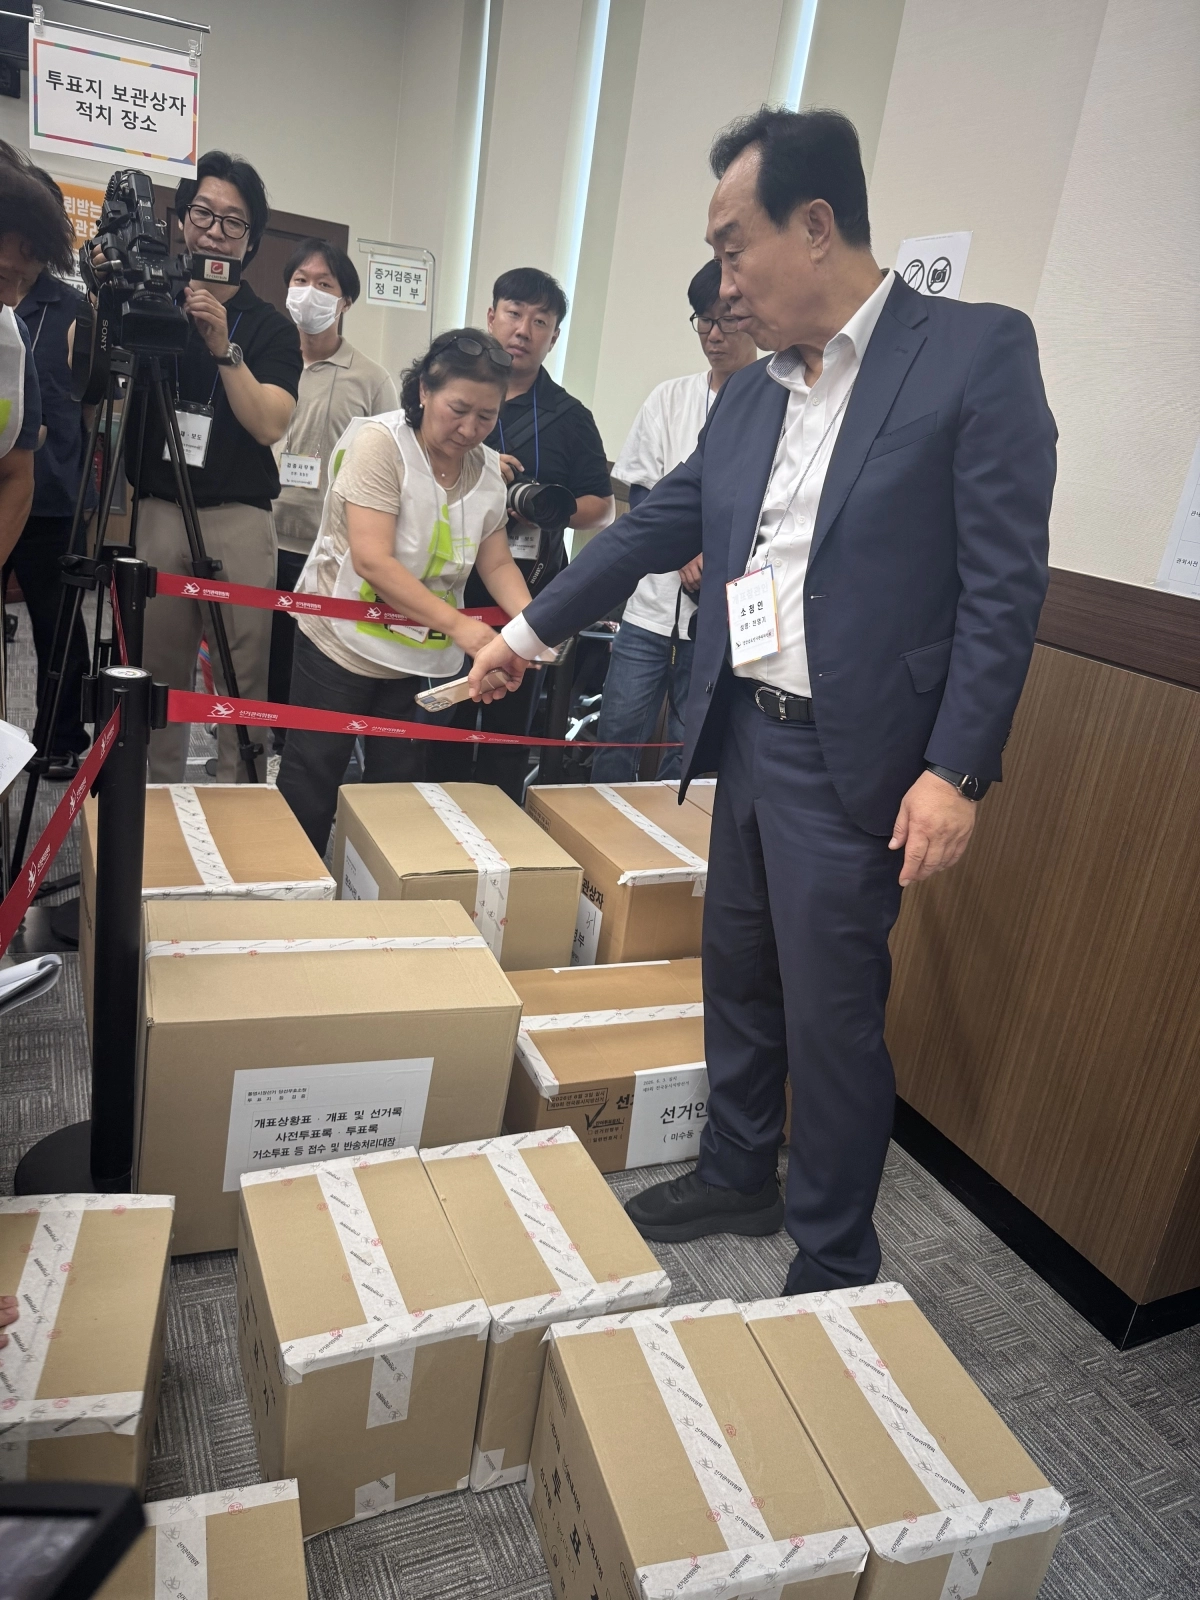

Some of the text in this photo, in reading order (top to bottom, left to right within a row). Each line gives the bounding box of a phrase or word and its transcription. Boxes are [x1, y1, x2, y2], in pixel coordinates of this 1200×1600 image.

[46, 70, 186, 116] 투표지 보관상자
[76, 100, 158, 132] 적치 장소
[374, 268, 422, 284] 증거검증부
[376, 282, 419, 299] 정 리 부
[101, 320, 109, 351] SONY
[530, 563, 544, 584] Canon
[254, 1107, 402, 1128] 개표상황표 개표 및 선거록
[275, 1124, 378, 1142] 사전투표록 투표록
[671, 1130, 694, 1141] 미수동
[253, 1137, 396, 1159] 거소투표 등 접수 및 반송처리대장
